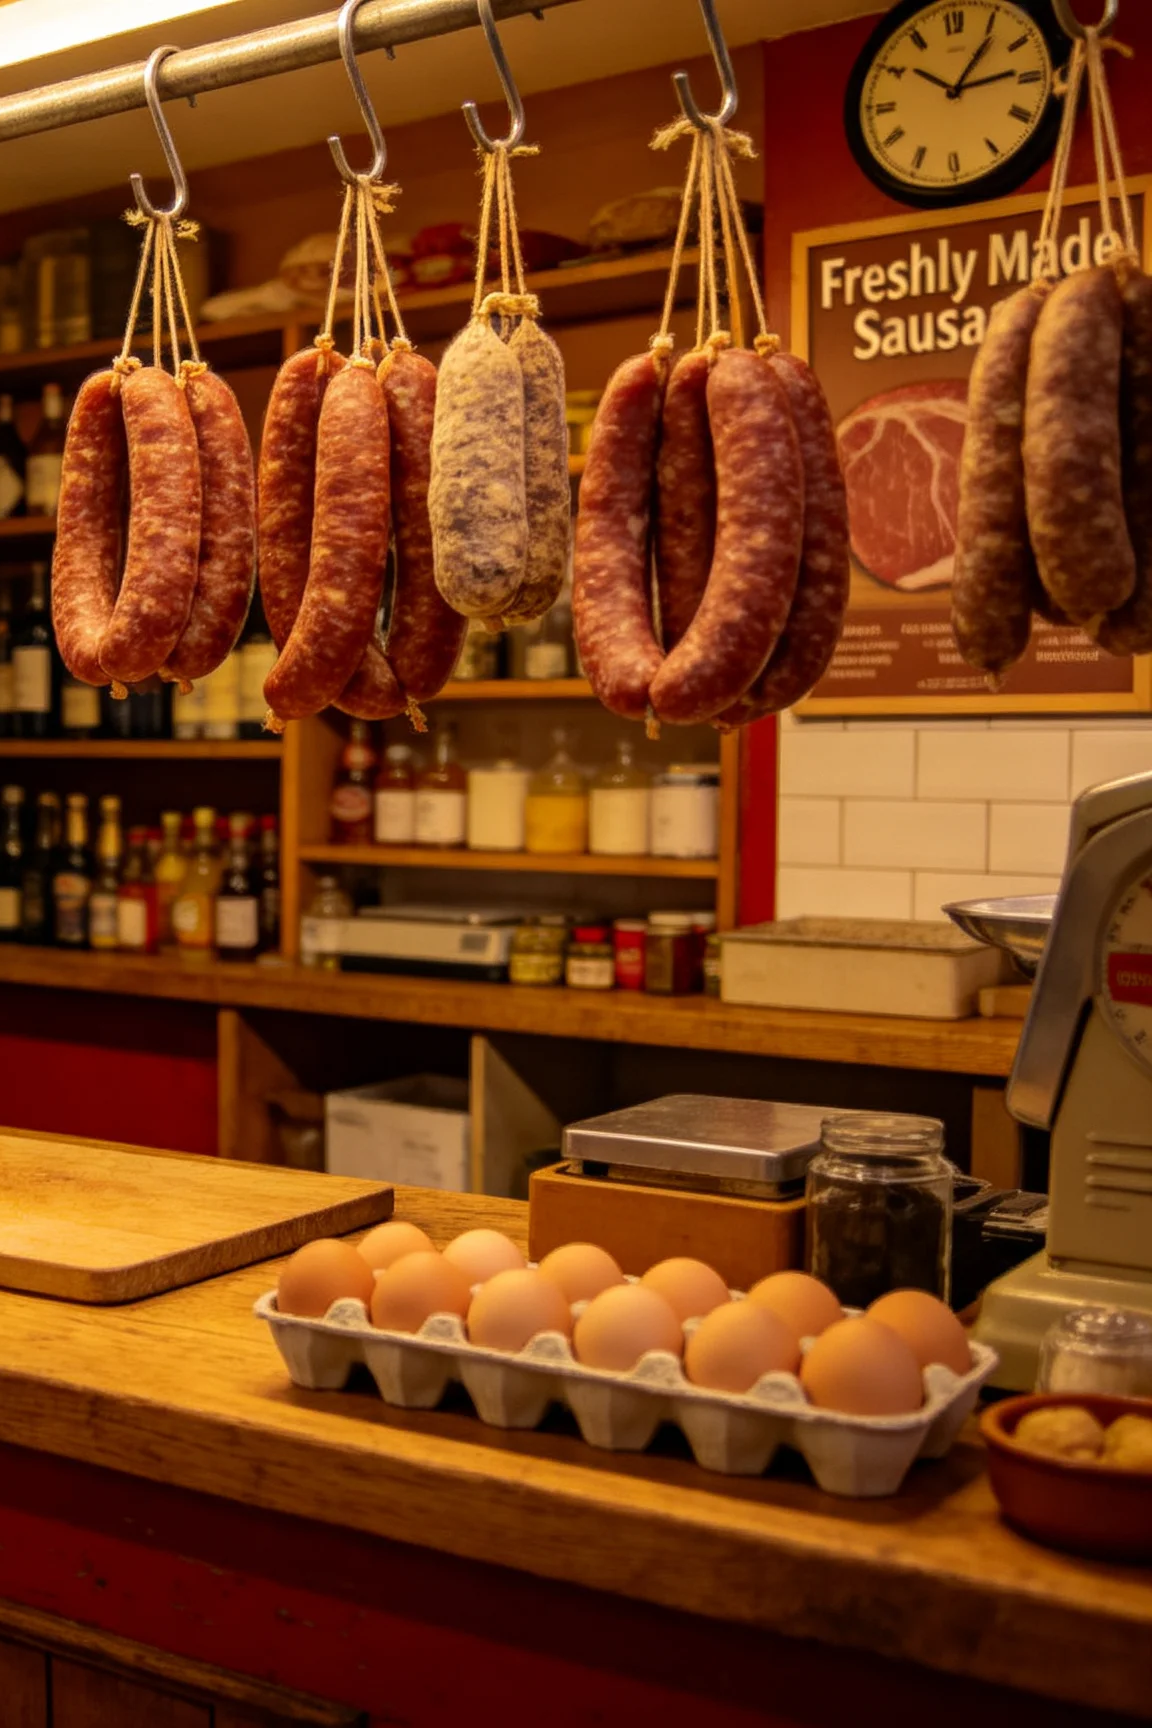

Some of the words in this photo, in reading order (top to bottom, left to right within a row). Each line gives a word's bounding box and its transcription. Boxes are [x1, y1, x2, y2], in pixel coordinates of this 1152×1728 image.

[820, 238, 978, 309] Freshly
[988, 217, 1122, 286] Made
[853, 305, 987, 360] Sausa
